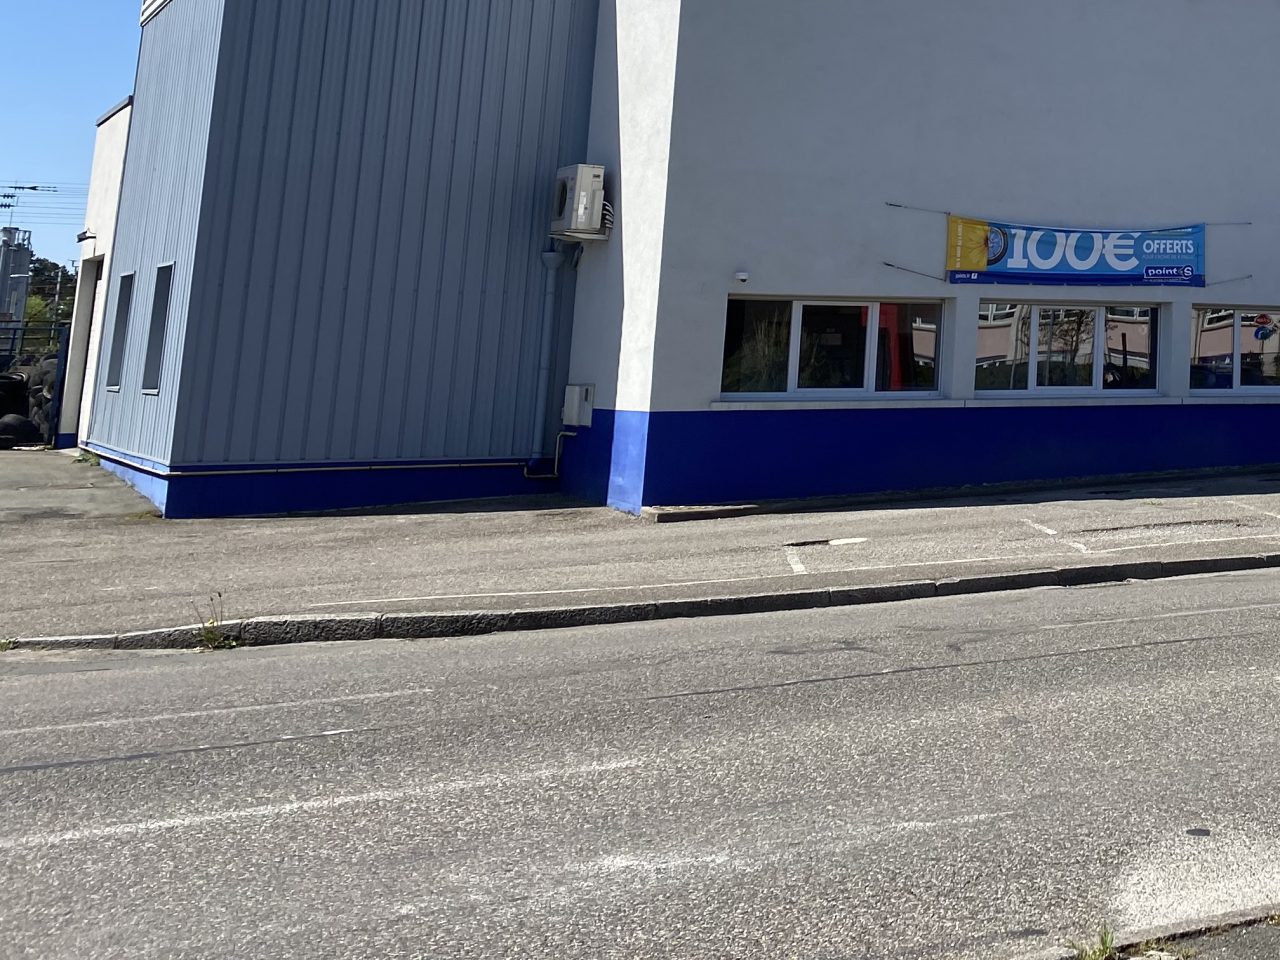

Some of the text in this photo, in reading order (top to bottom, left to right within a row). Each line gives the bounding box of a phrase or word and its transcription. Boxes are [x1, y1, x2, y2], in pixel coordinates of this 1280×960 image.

[1007, 228, 1142, 271] 100€
[1143, 239, 1194, 254] OFFERTS
[1148, 266, 1192, 276] point S
